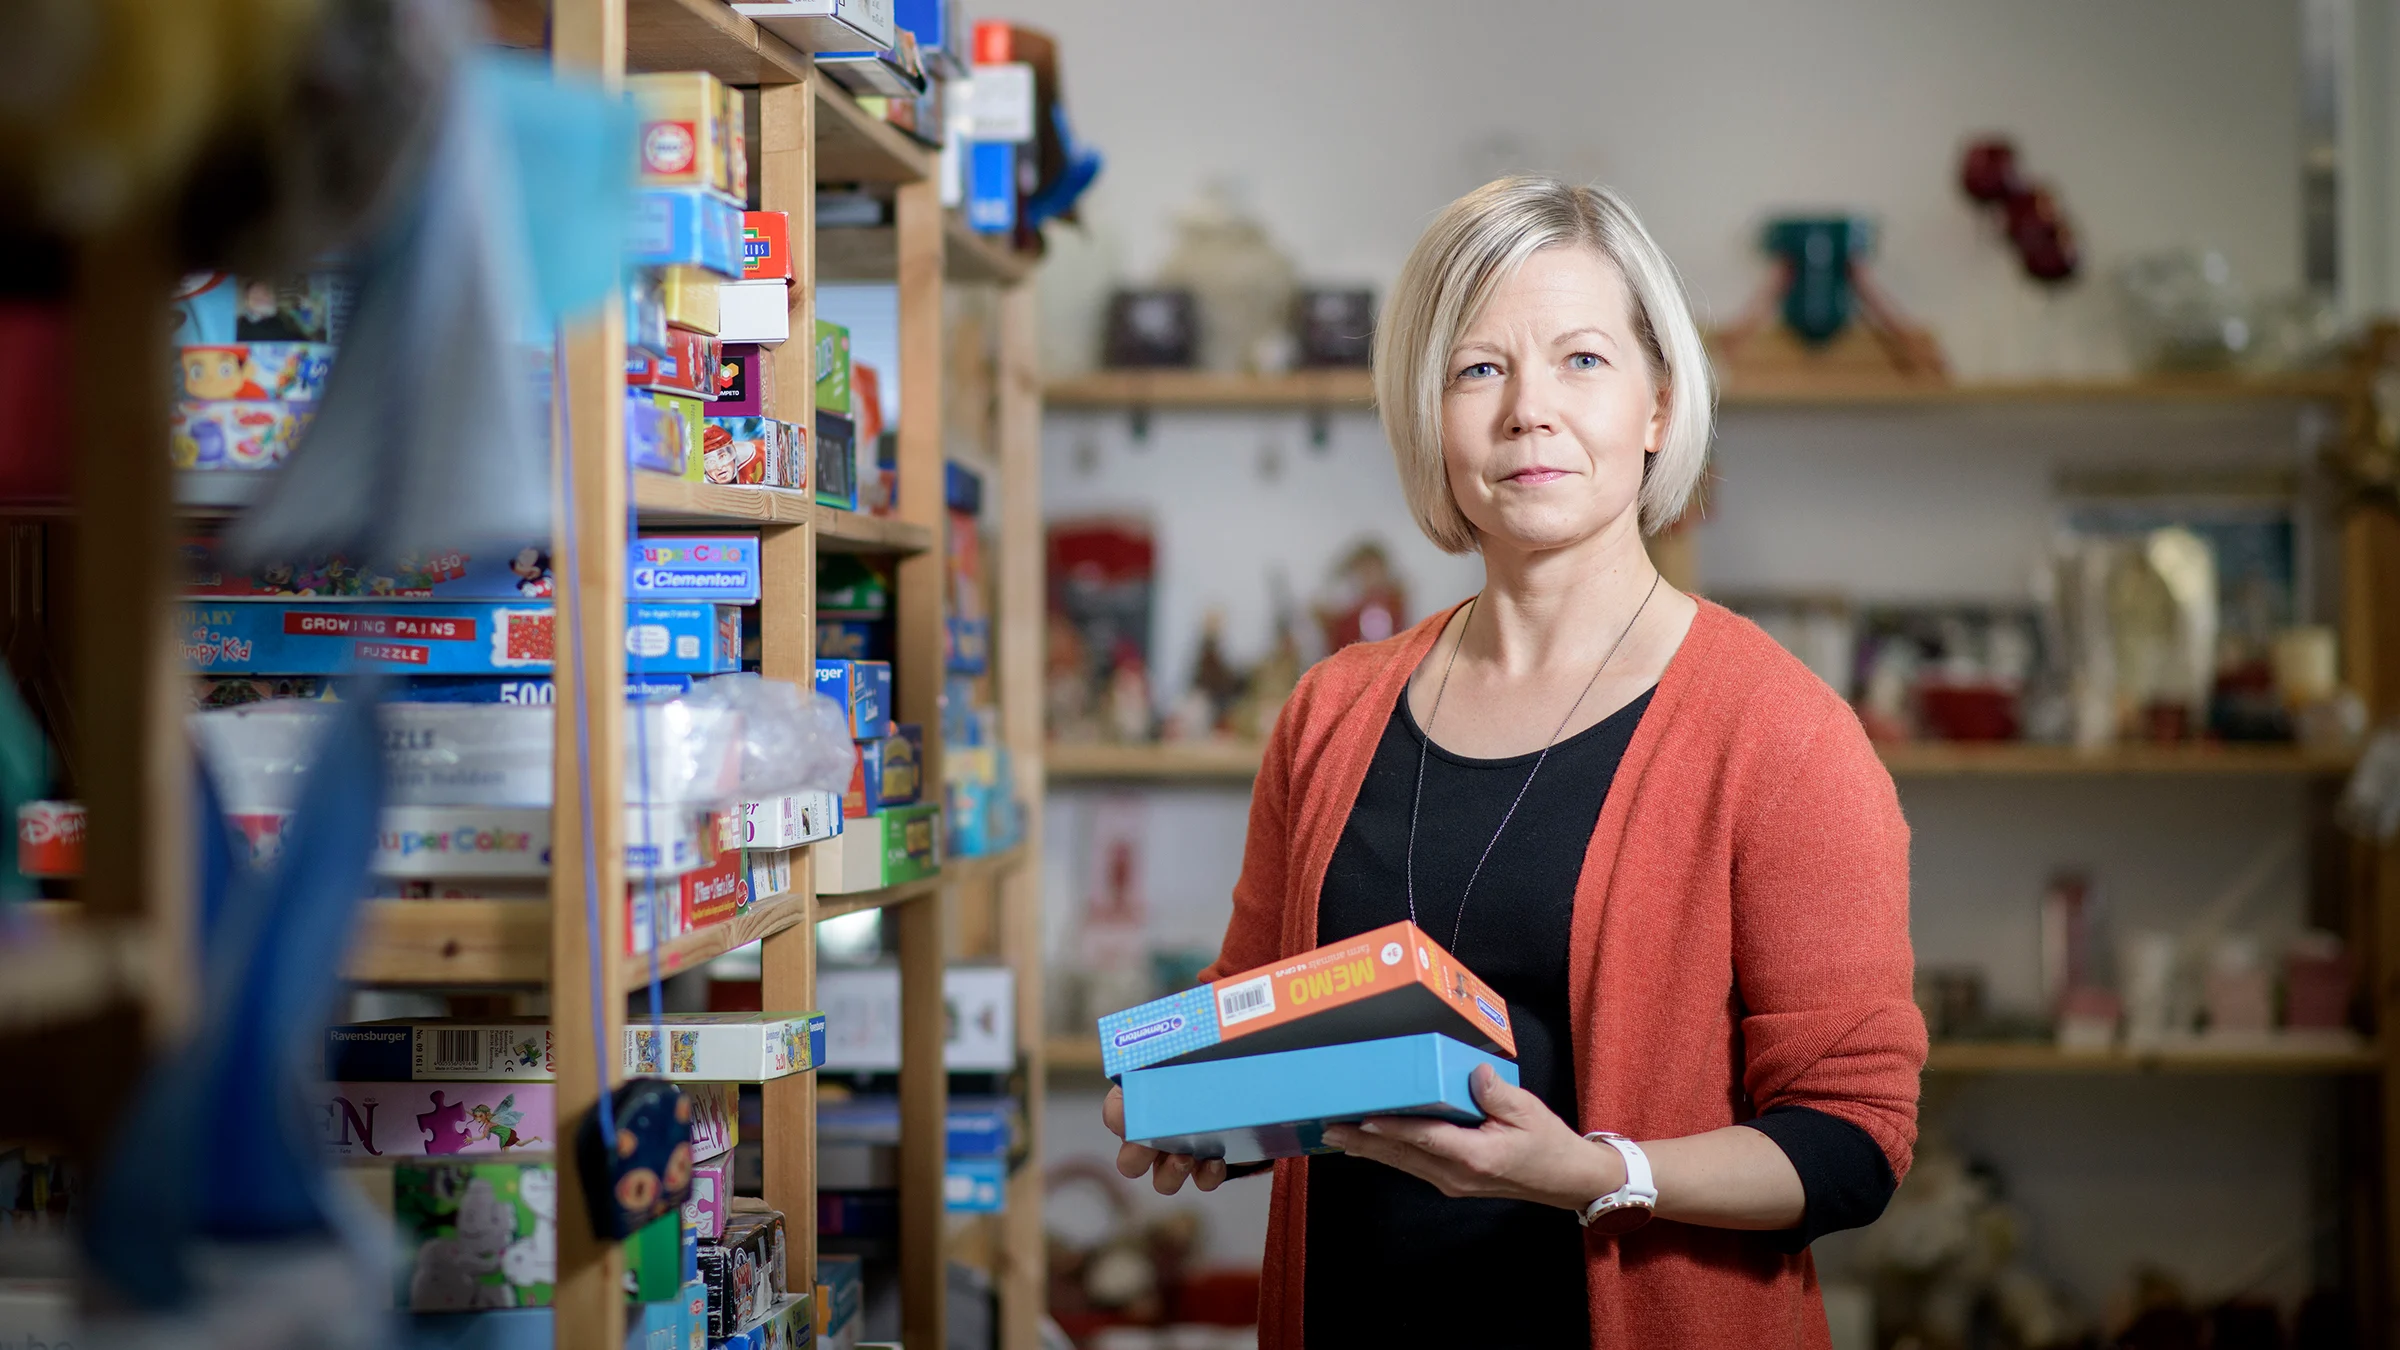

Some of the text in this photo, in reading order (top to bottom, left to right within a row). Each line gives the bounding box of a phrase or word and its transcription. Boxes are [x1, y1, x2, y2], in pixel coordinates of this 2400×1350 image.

[431, 553, 462, 574] 150
[655, 570, 747, 587] Clementoni
[302, 617, 456, 636] GROWING PAINS
[221, 633, 252, 662] Kid
[381, 826, 532, 857] uperColor
[1289, 956, 1376, 1006] MEMO
[330, 1030, 407, 1044] Ravensburger
[415, 1029, 424, 1042] No.
[1119, 1021, 1171, 1046] Clementoni
[415, 1043, 424, 1053] 09
[415, 1054, 424, 1067] 161
